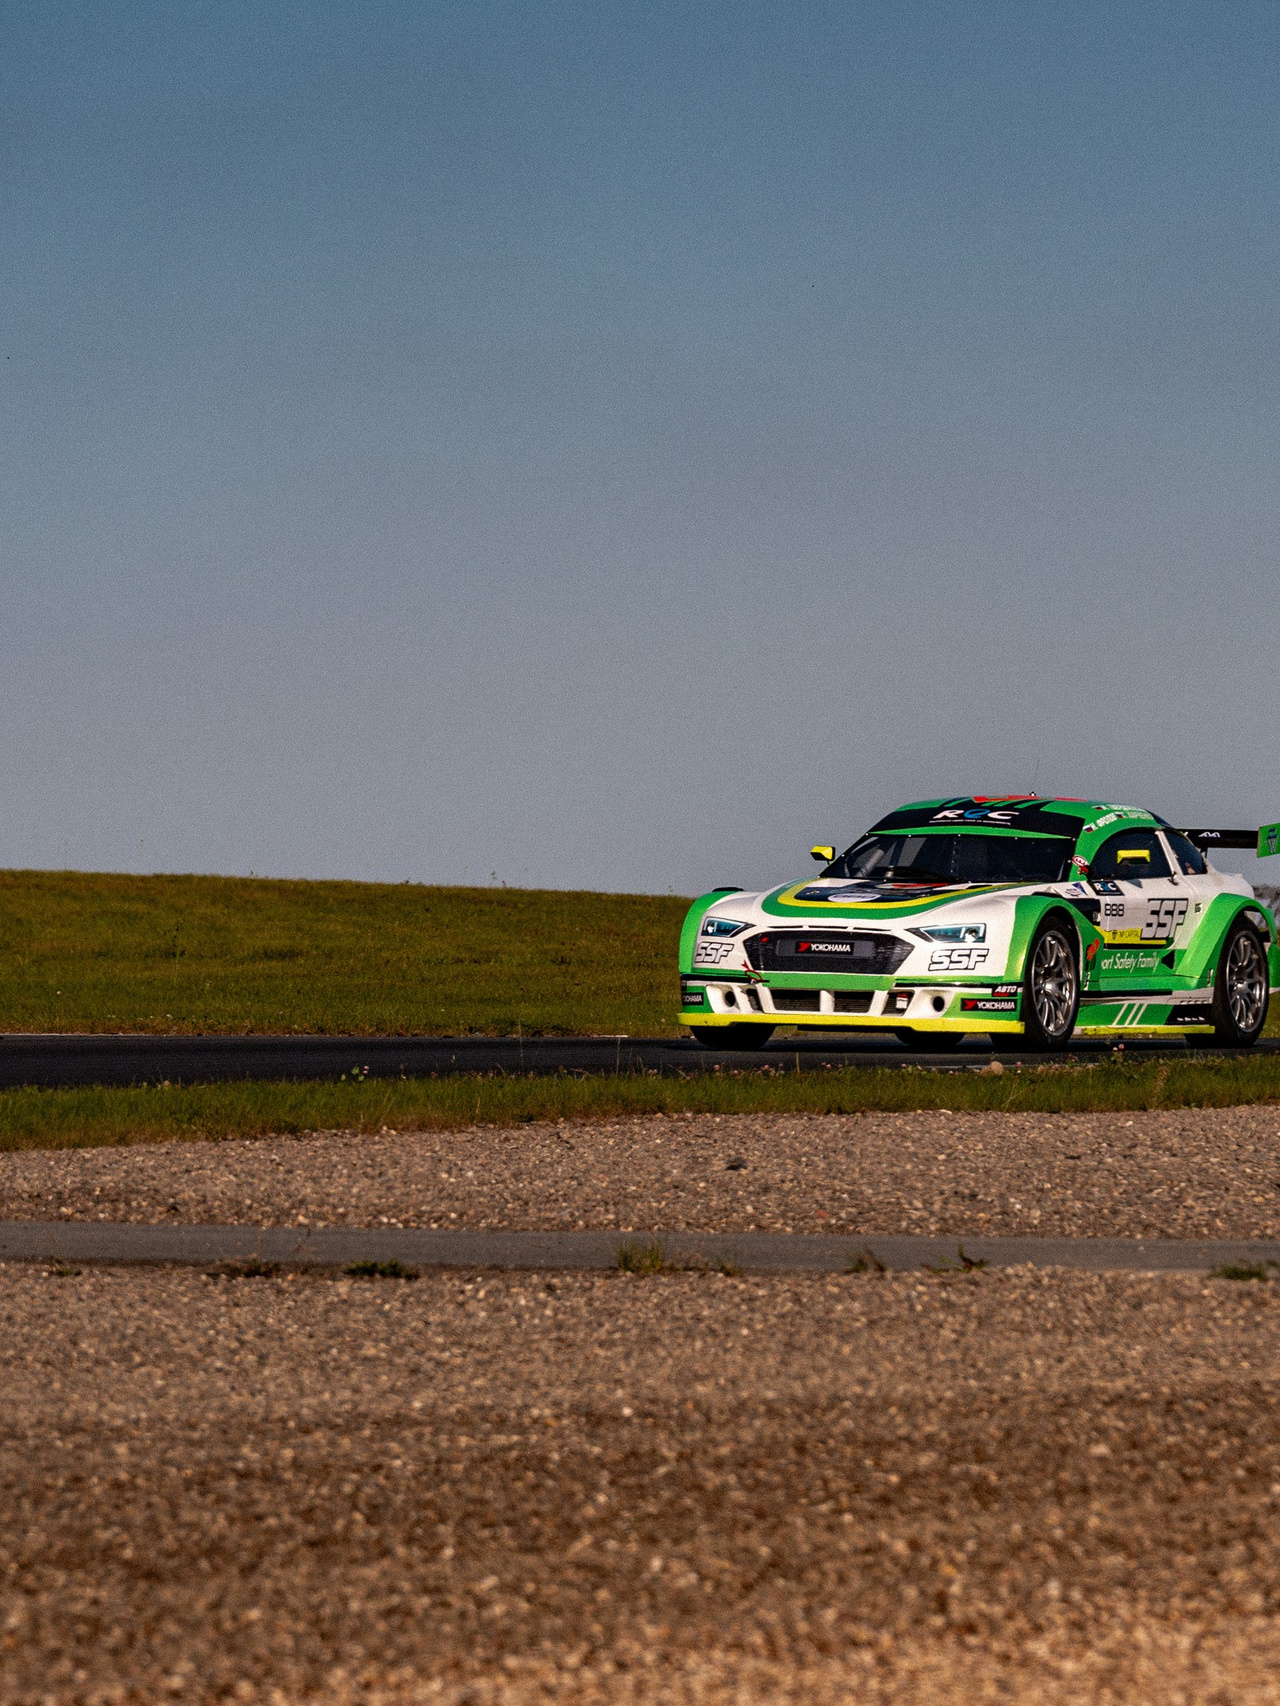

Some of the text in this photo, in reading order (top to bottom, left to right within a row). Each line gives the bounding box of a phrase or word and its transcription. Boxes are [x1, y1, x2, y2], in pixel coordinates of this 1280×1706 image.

[1104, 903, 1125, 917] 888
[1140, 898, 1189, 940] SSF
[694, 941, 735, 964] SSF
[810, 943, 851, 952] YOKOHAMA
[928, 948, 990, 972] SSF
[1114, 952, 1137, 973] Safety
[1136, 951, 1160, 973] Family
[977, 1001, 1016, 1010] YOKOHAMA
